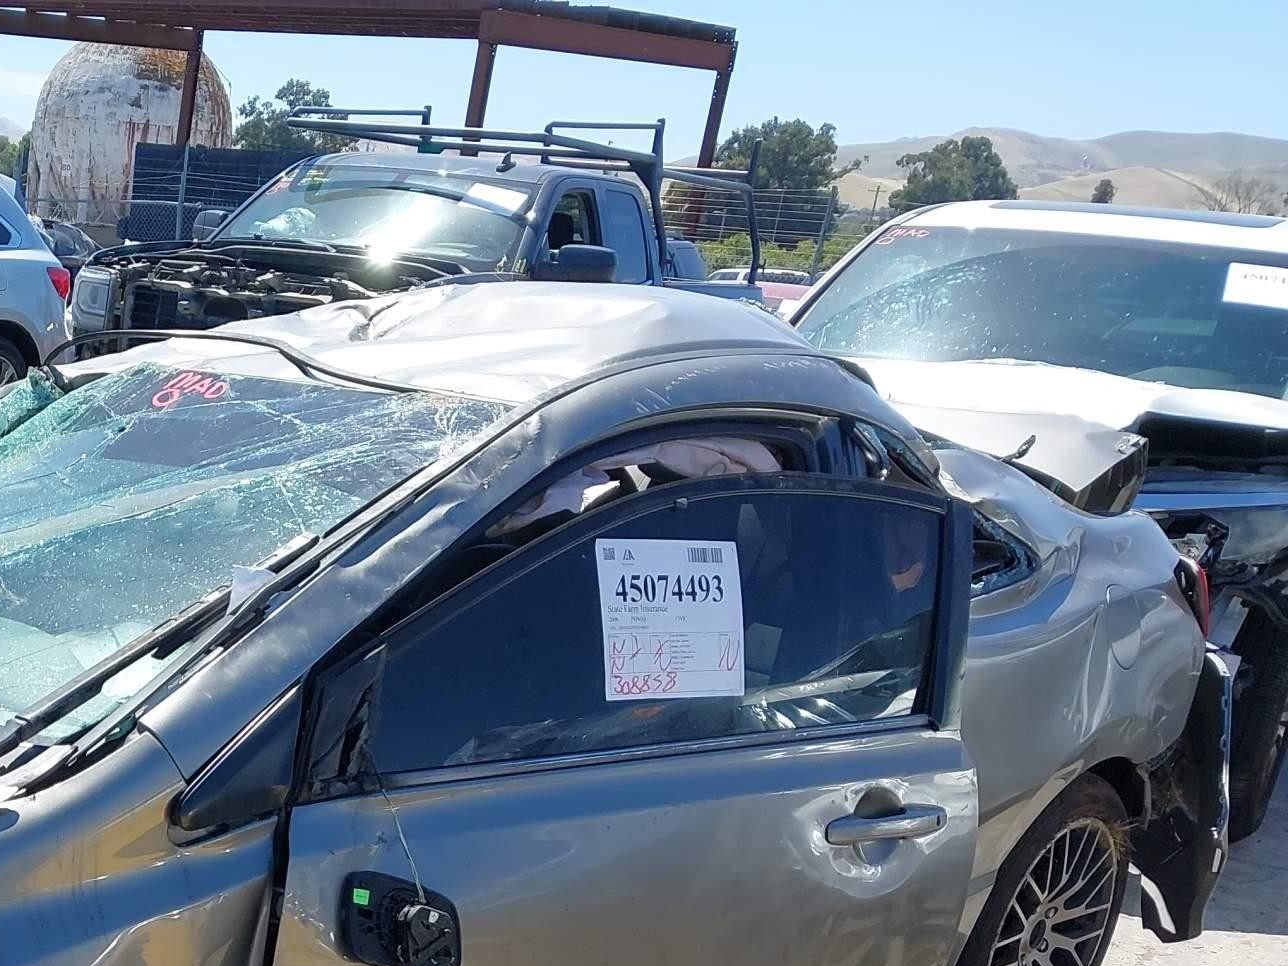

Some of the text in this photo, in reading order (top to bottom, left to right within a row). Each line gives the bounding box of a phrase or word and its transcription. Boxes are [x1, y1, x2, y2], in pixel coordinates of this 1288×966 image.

[163, 371, 227, 399] MAD
[615, 574, 724, 603] 45074493
[607, 605, 623, 613] State
[640, 605, 668, 614] Insurance
